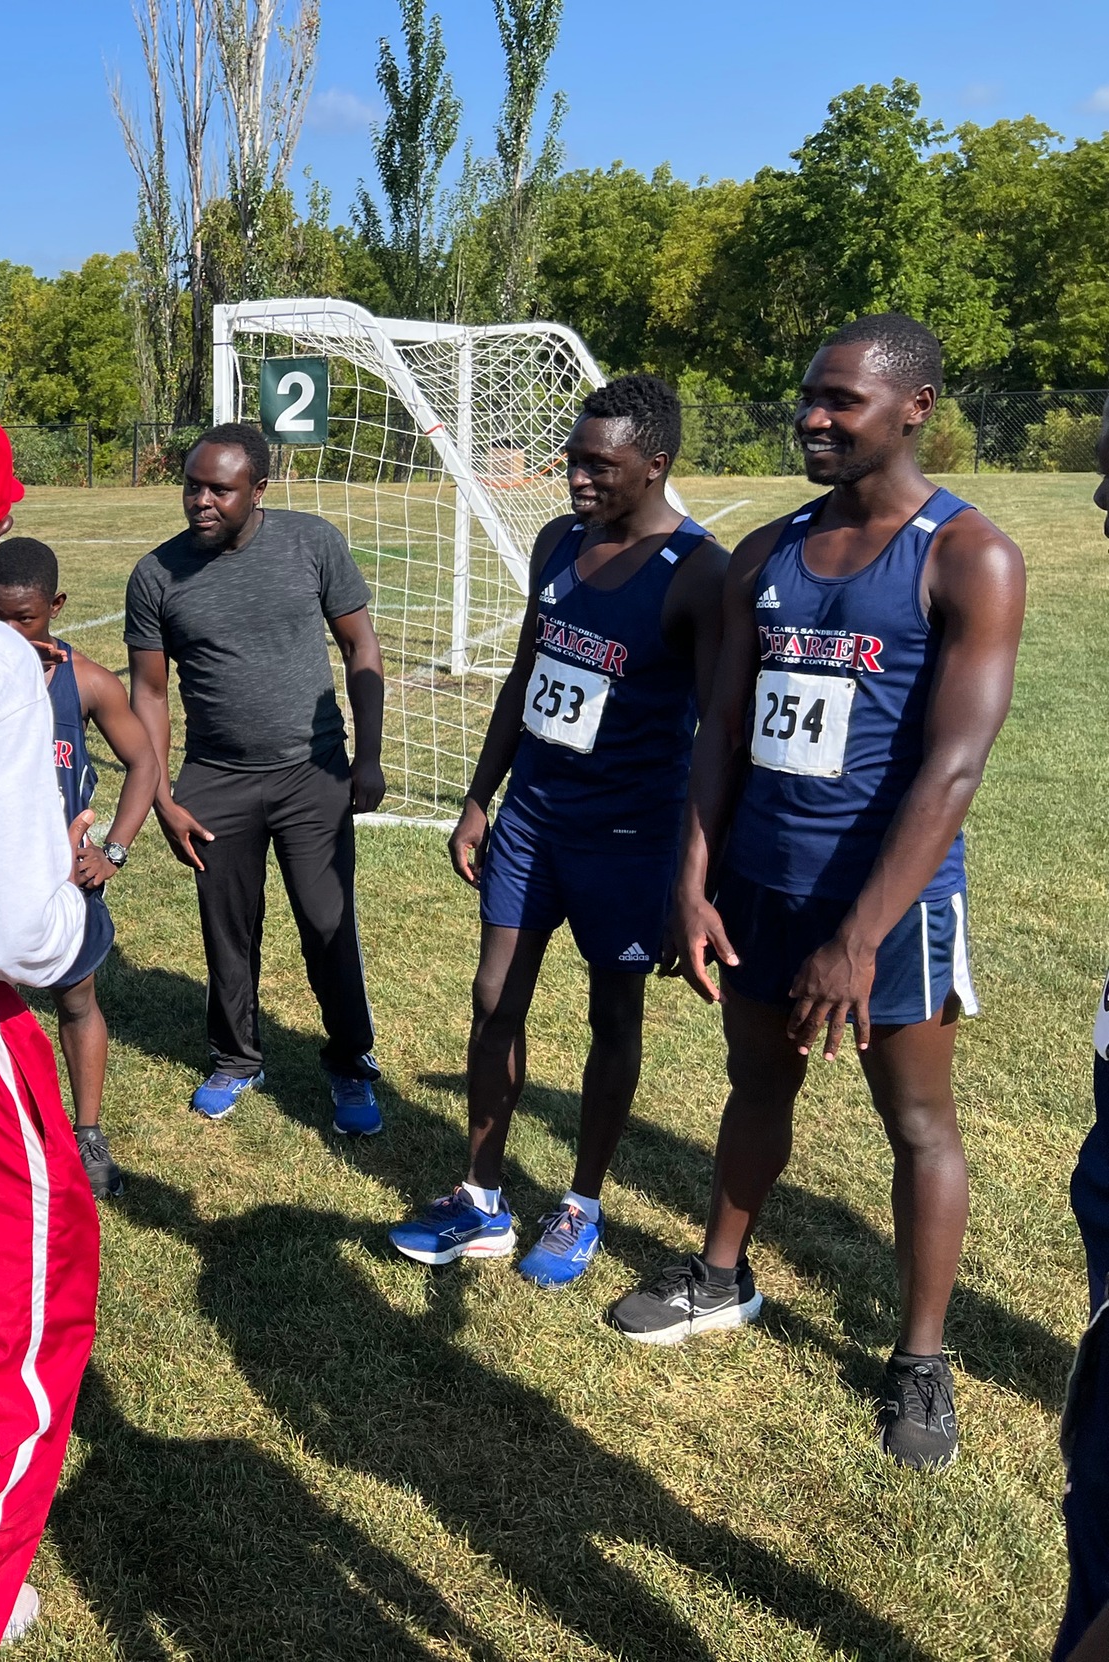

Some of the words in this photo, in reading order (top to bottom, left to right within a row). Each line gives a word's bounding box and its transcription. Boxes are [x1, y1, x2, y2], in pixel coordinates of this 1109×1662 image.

[274, 371, 315, 432] 2
[756, 600, 781, 609] adidas
[773, 626, 799, 635] CARL
[532, 673, 585, 725] 253
[761, 692, 826, 744] 254
[618, 953, 650, 961] adidas
